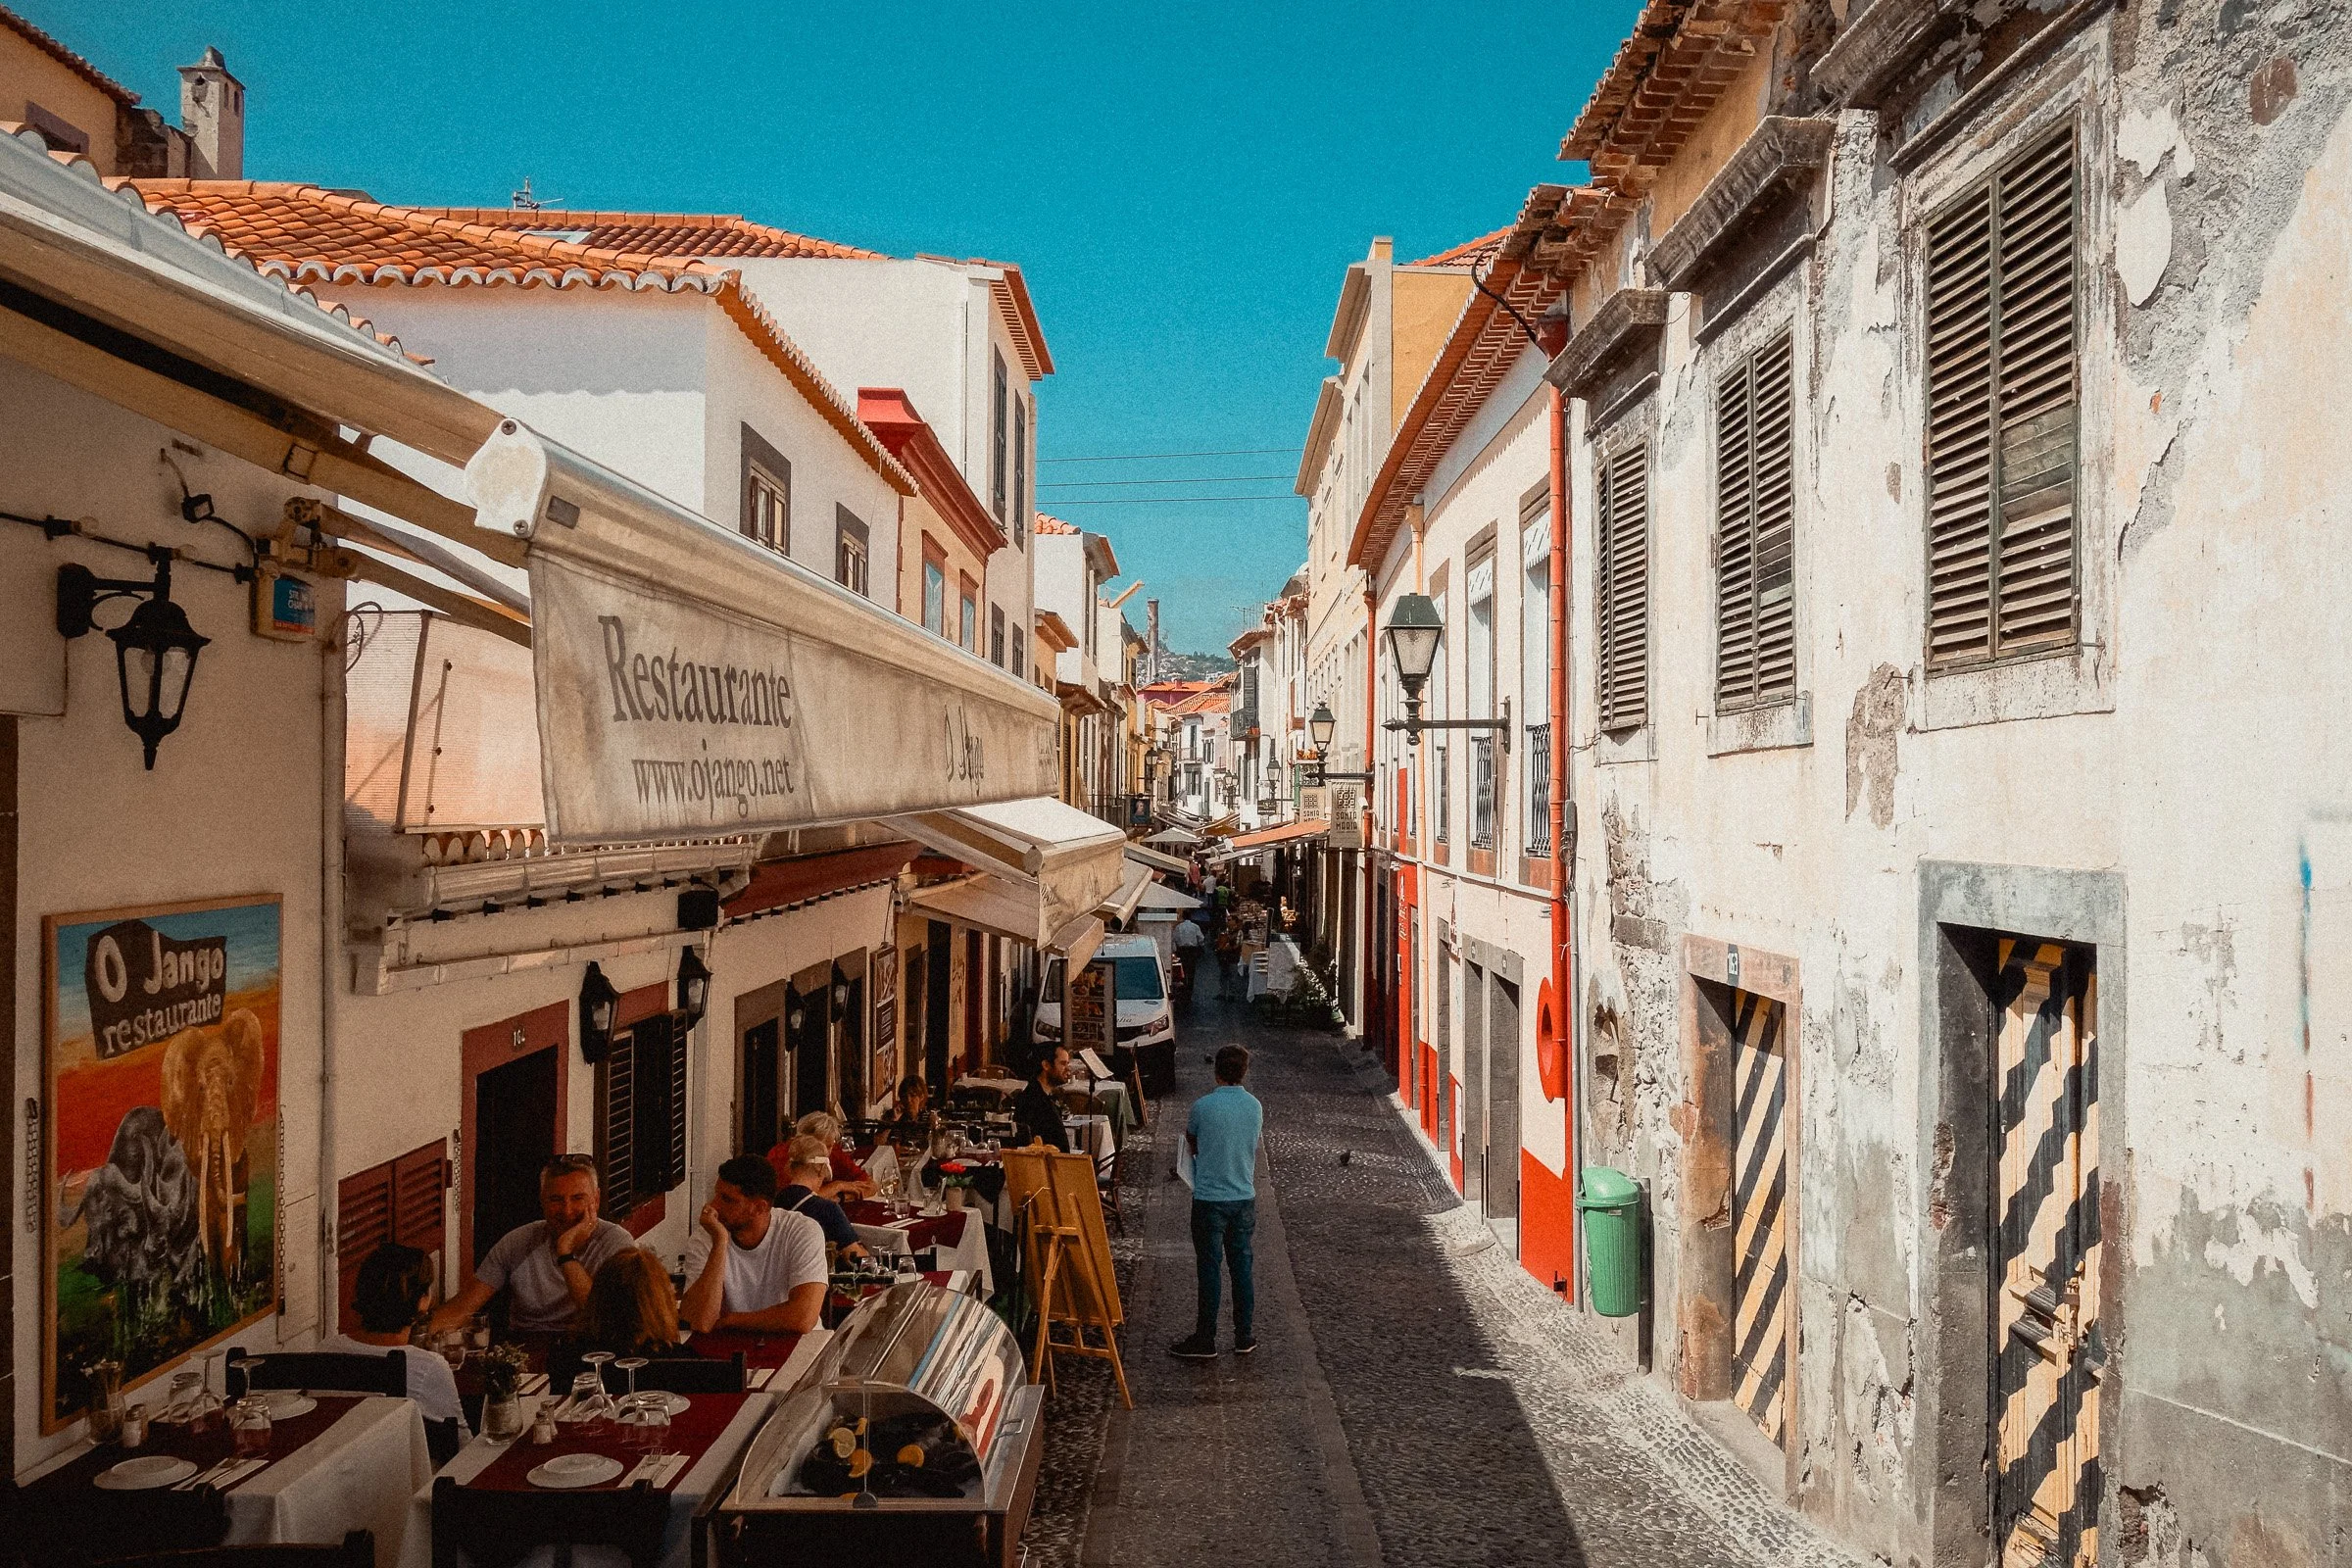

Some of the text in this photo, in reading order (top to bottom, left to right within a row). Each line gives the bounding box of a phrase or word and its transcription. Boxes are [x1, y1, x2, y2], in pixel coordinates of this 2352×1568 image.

[597, 614, 792, 729] Restaurante
[631, 738, 795, 819] www.ojango.net
[1335, 810, 1357, 820] SANTA
[1336, 821, 1358, 830] MARIA
[95, 930, 224, 1004] O Jango
[102, 992, 221, 1056] restaurante
